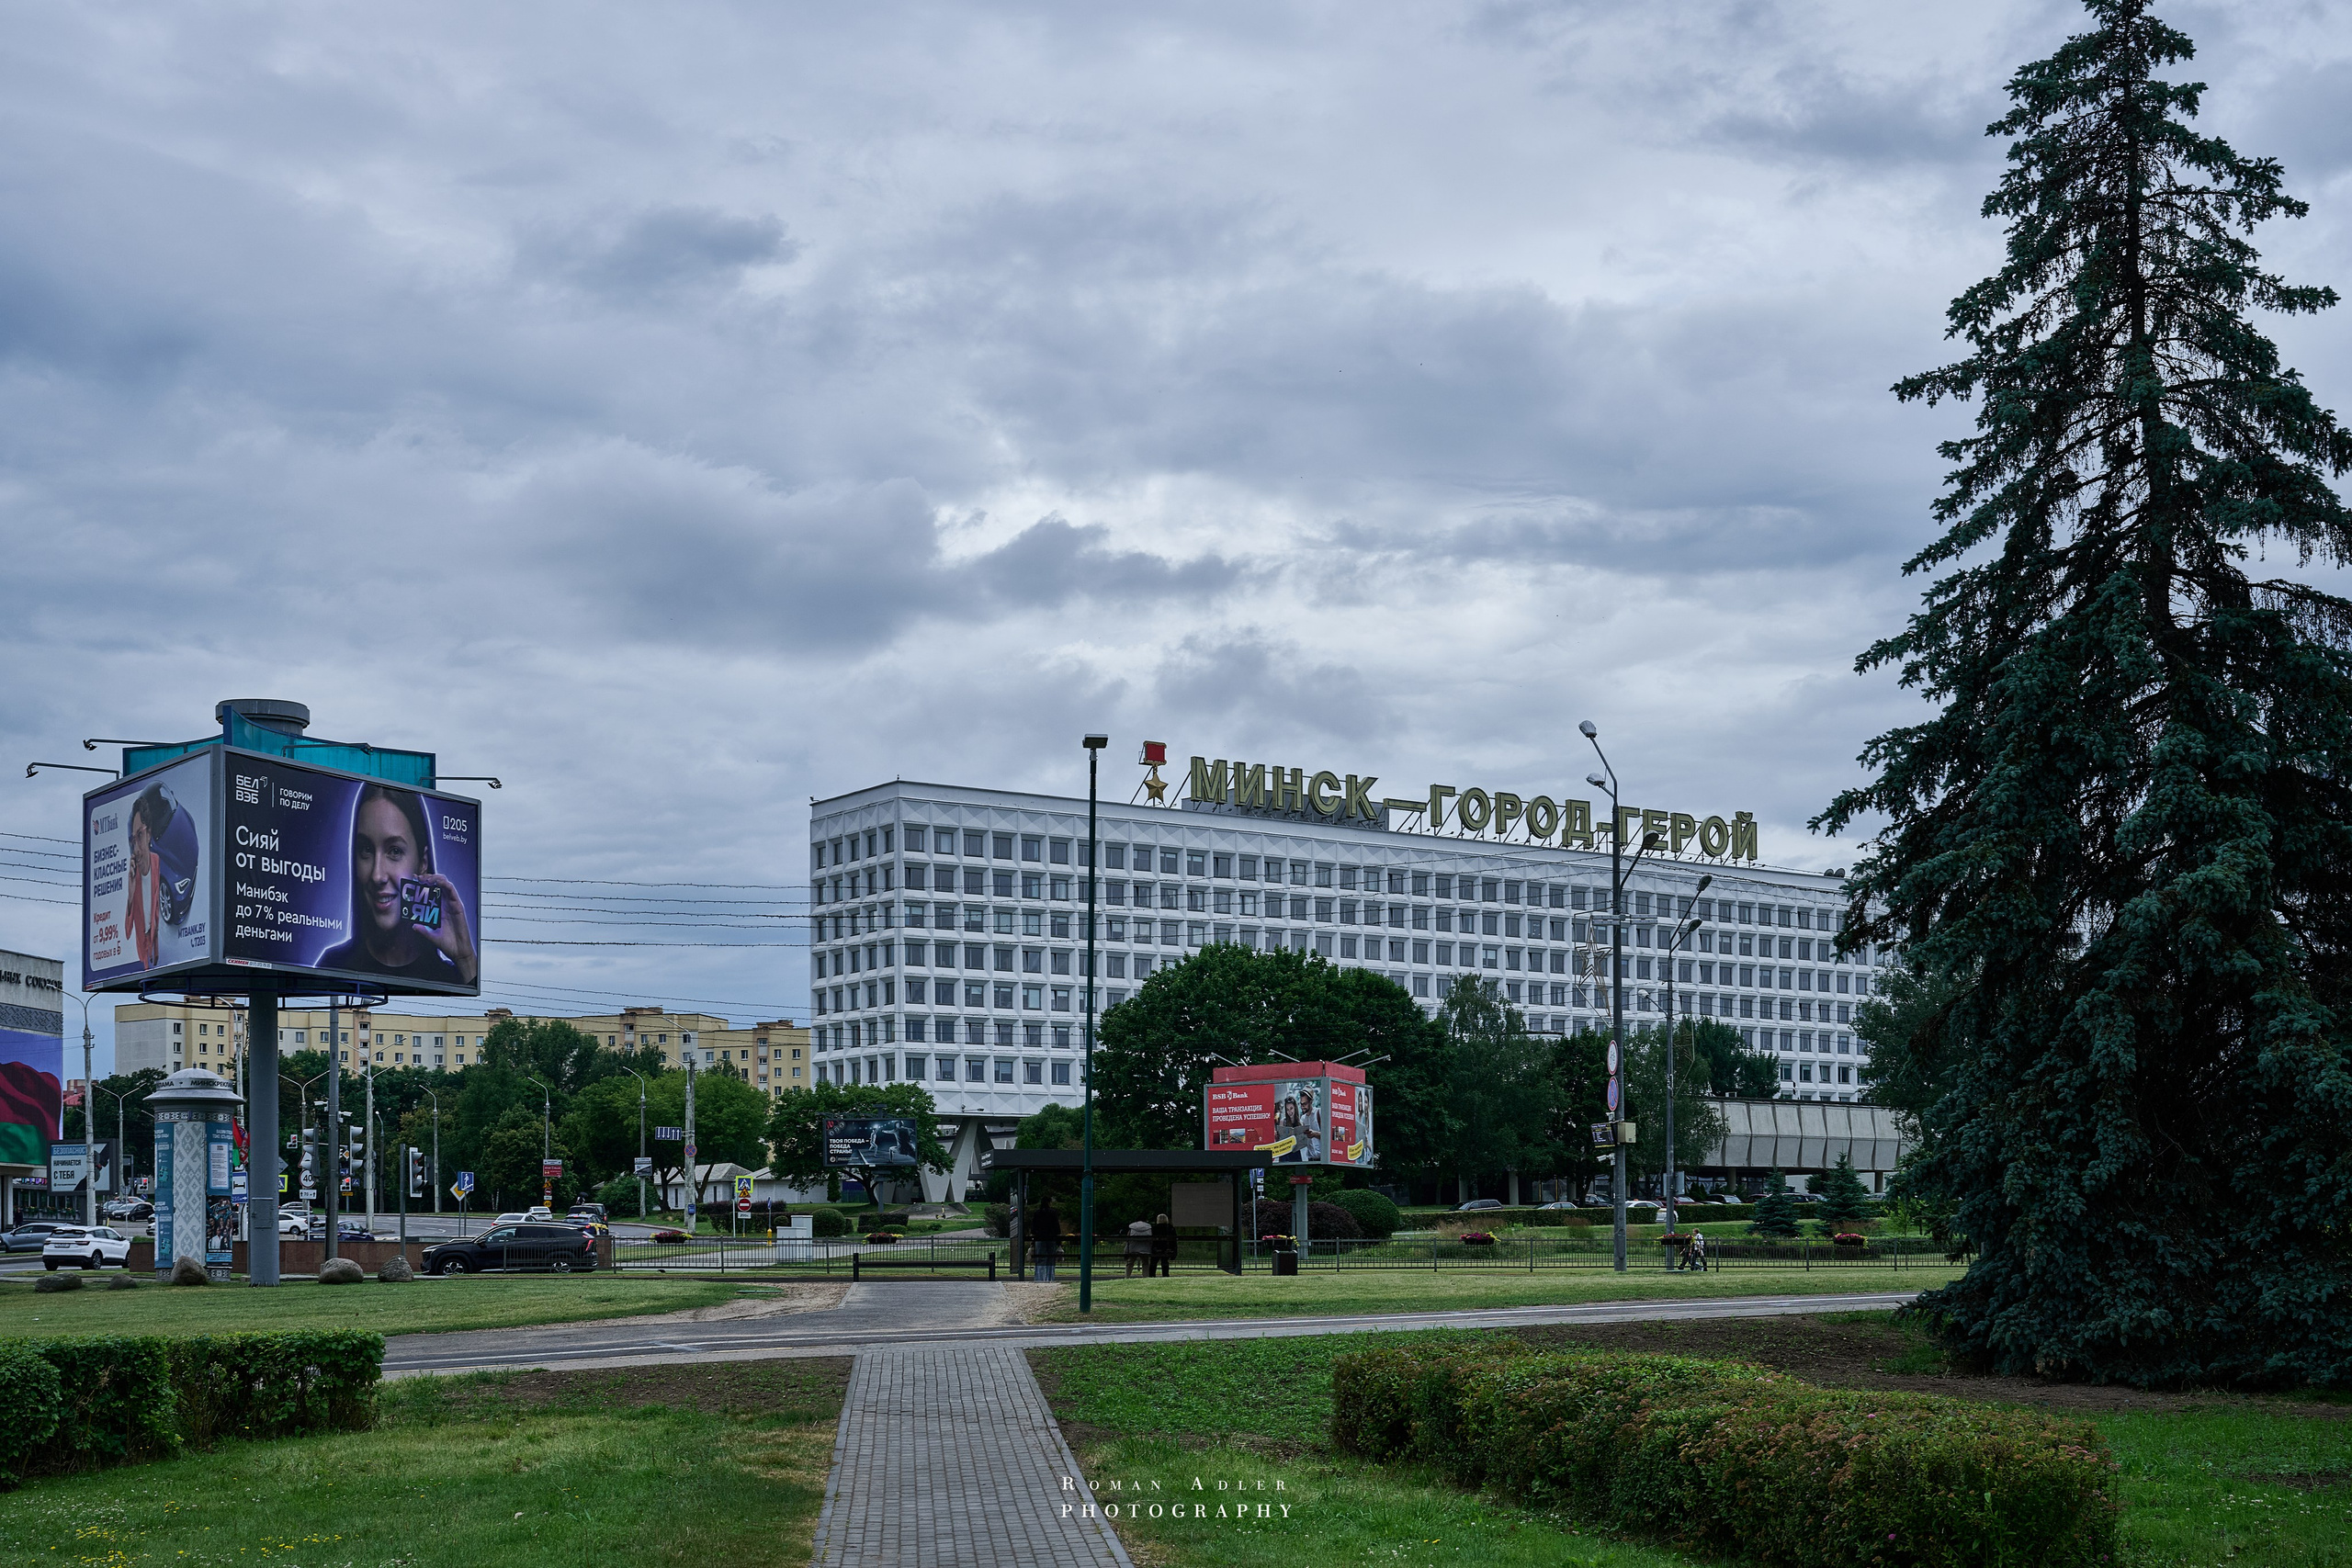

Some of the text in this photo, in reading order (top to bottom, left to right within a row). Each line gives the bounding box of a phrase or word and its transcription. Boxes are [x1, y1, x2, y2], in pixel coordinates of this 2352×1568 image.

[236, 775, 259, 789] БЕЛ
[1191, 756, 1378, 820] МИНСК
[236, 790, 259, 804] ВЭБ
[280, 788, 312, 801] ГОВОРИМ
[280, 798, 310, 811] ПО ДЕЛУ
[450, 818, 468, 832] 205
[236, 825, 279, 852] Сияй
[443, 832, 468, 844] belveb.by
[94, 844, 119, 863] БИЗНЕС-
[94, 858, 127, 880] КЛАССНЫЕ
[236, 852, 325, 883] от выгоды
[94, 877, 123, 898] РЕШЕНИЯ
[236, 881, 288, 903] Манибэк
[93, 911, 111, 925] Кредит
[236, 904, 252, 918] до
[277, 911, 343, 930] реальными
[99, 925, 119, 944] 9,99%
[178, 922, 206, 939] MTBANK.BY
[236, 925, 292, 942] деньгами
[194, 936, 206, 948] 7203
[93, 947, 112, 961] годовых
[54, 1170, 74, 1179] С ТЕБЯ
